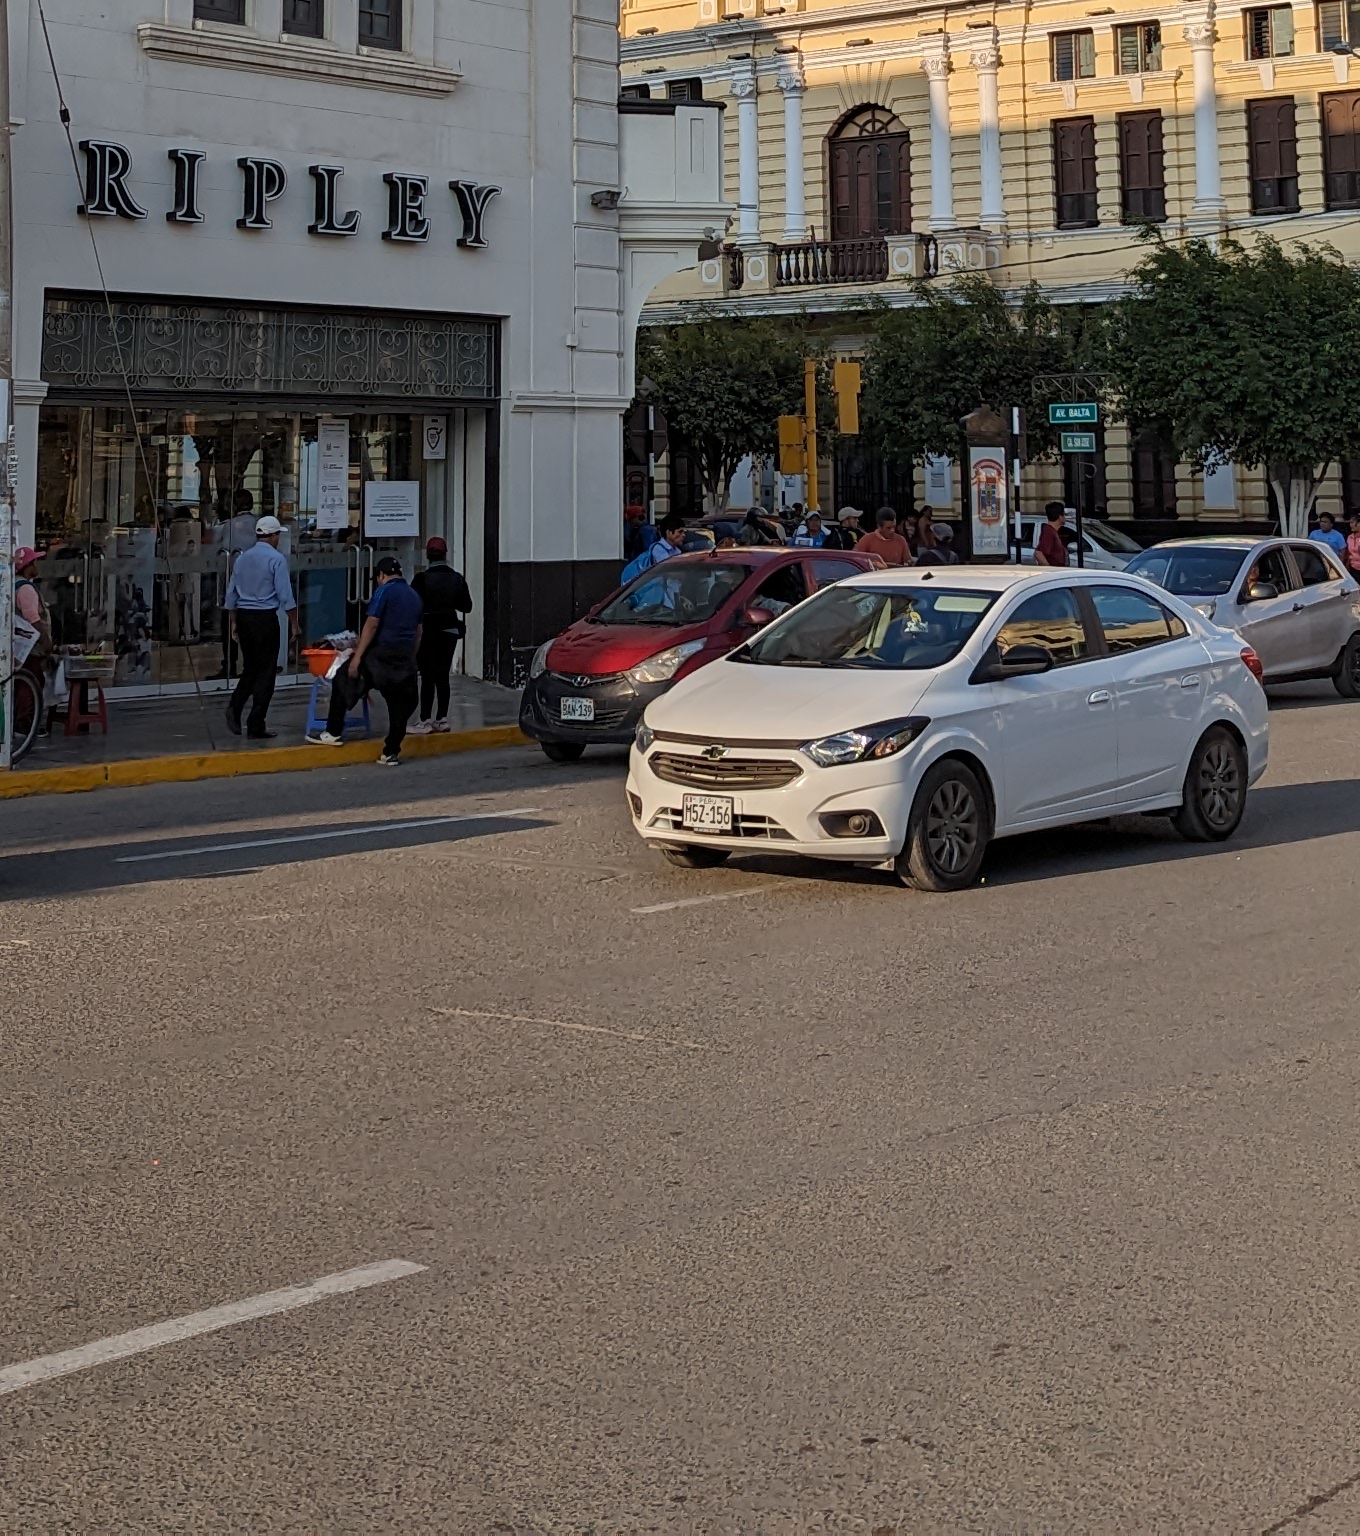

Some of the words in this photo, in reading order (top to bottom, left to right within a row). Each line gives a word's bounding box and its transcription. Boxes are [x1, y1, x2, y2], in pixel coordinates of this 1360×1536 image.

[77, 139, 502, 248] RIPLEY
[1069, 408, 1090, 417] BALTA
[562, 704, 592, 716] BAN-139
[685, 803, 730, 825] M5Z-156
